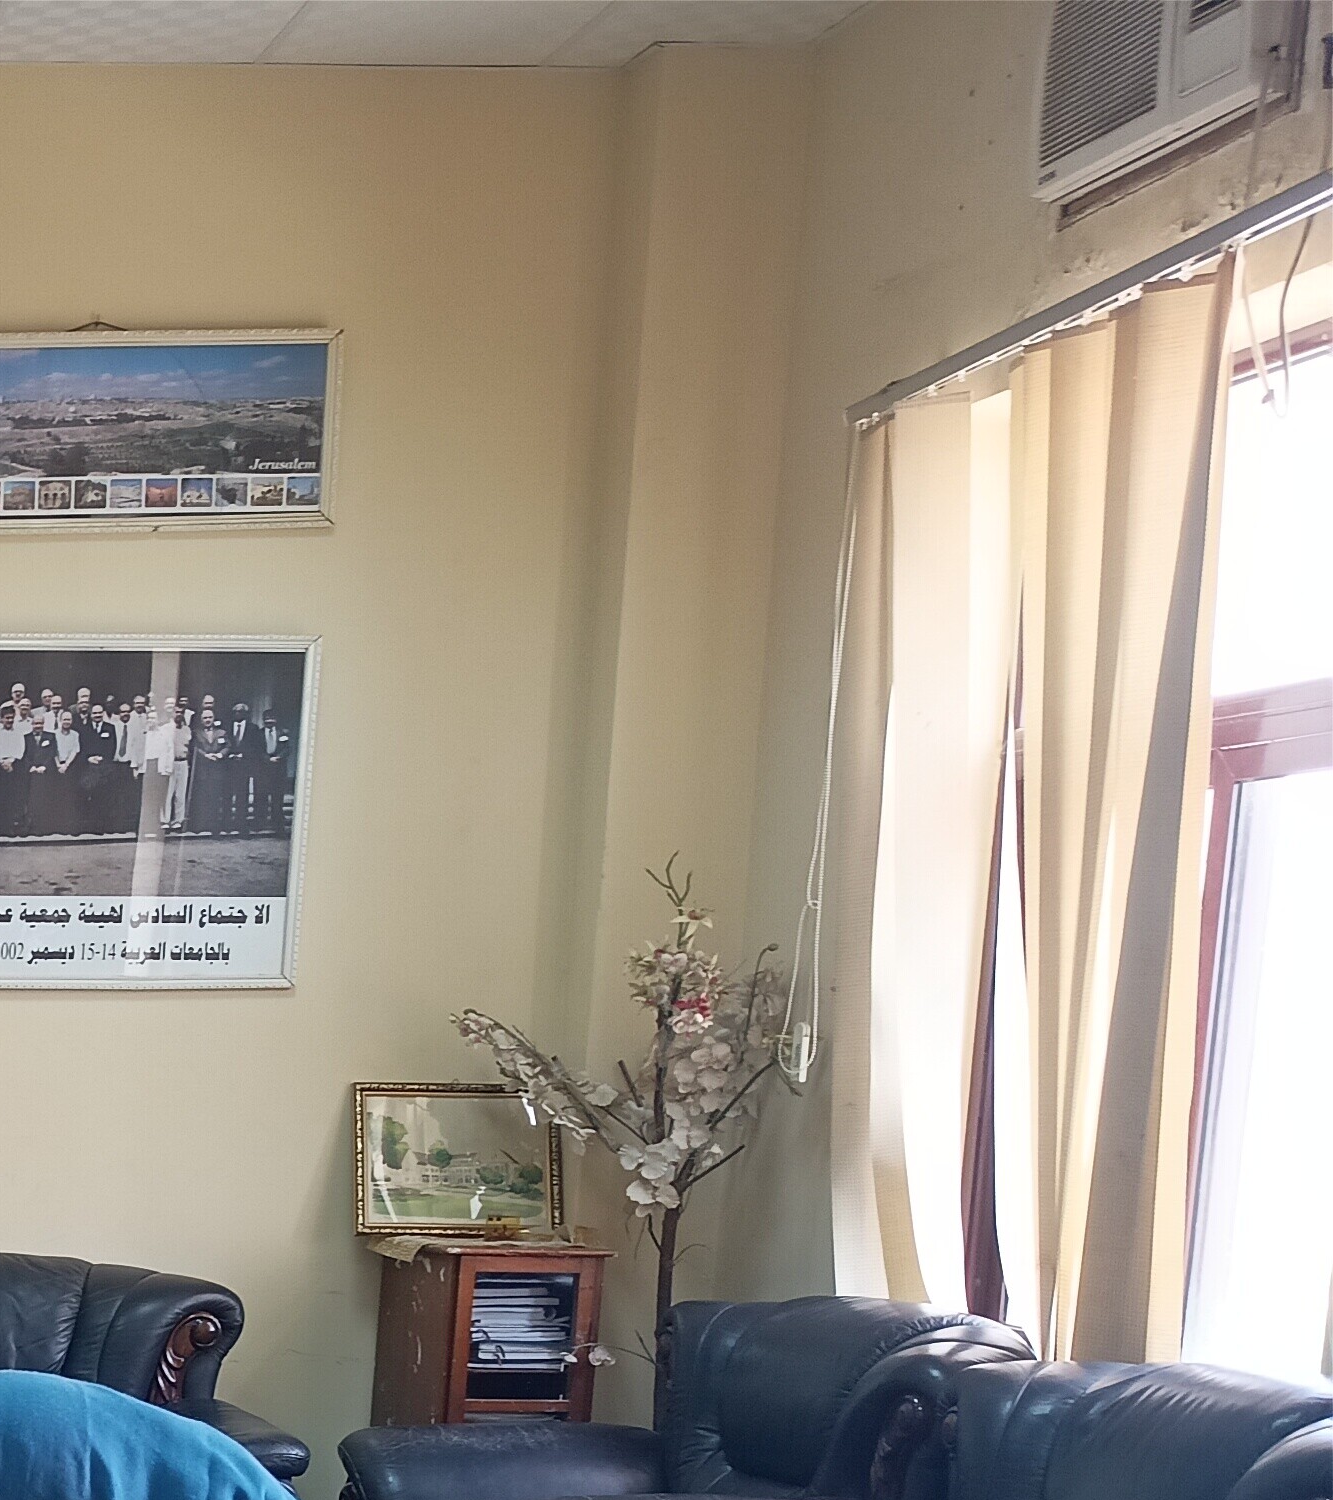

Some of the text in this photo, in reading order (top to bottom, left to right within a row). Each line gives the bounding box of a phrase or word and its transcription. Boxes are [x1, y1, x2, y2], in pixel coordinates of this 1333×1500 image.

[249, 458, 316, 470] Jerusalem
[20, 902, 71, 928] جمعية
[78, 902, 123, 928] لهيئة
[130, 903, 193, 928] السادس
[27, 944, 75, 965] ديسمبر
[120, 940, 167, 965] العربية
[170, 942, 230, 965] بالجامعات
